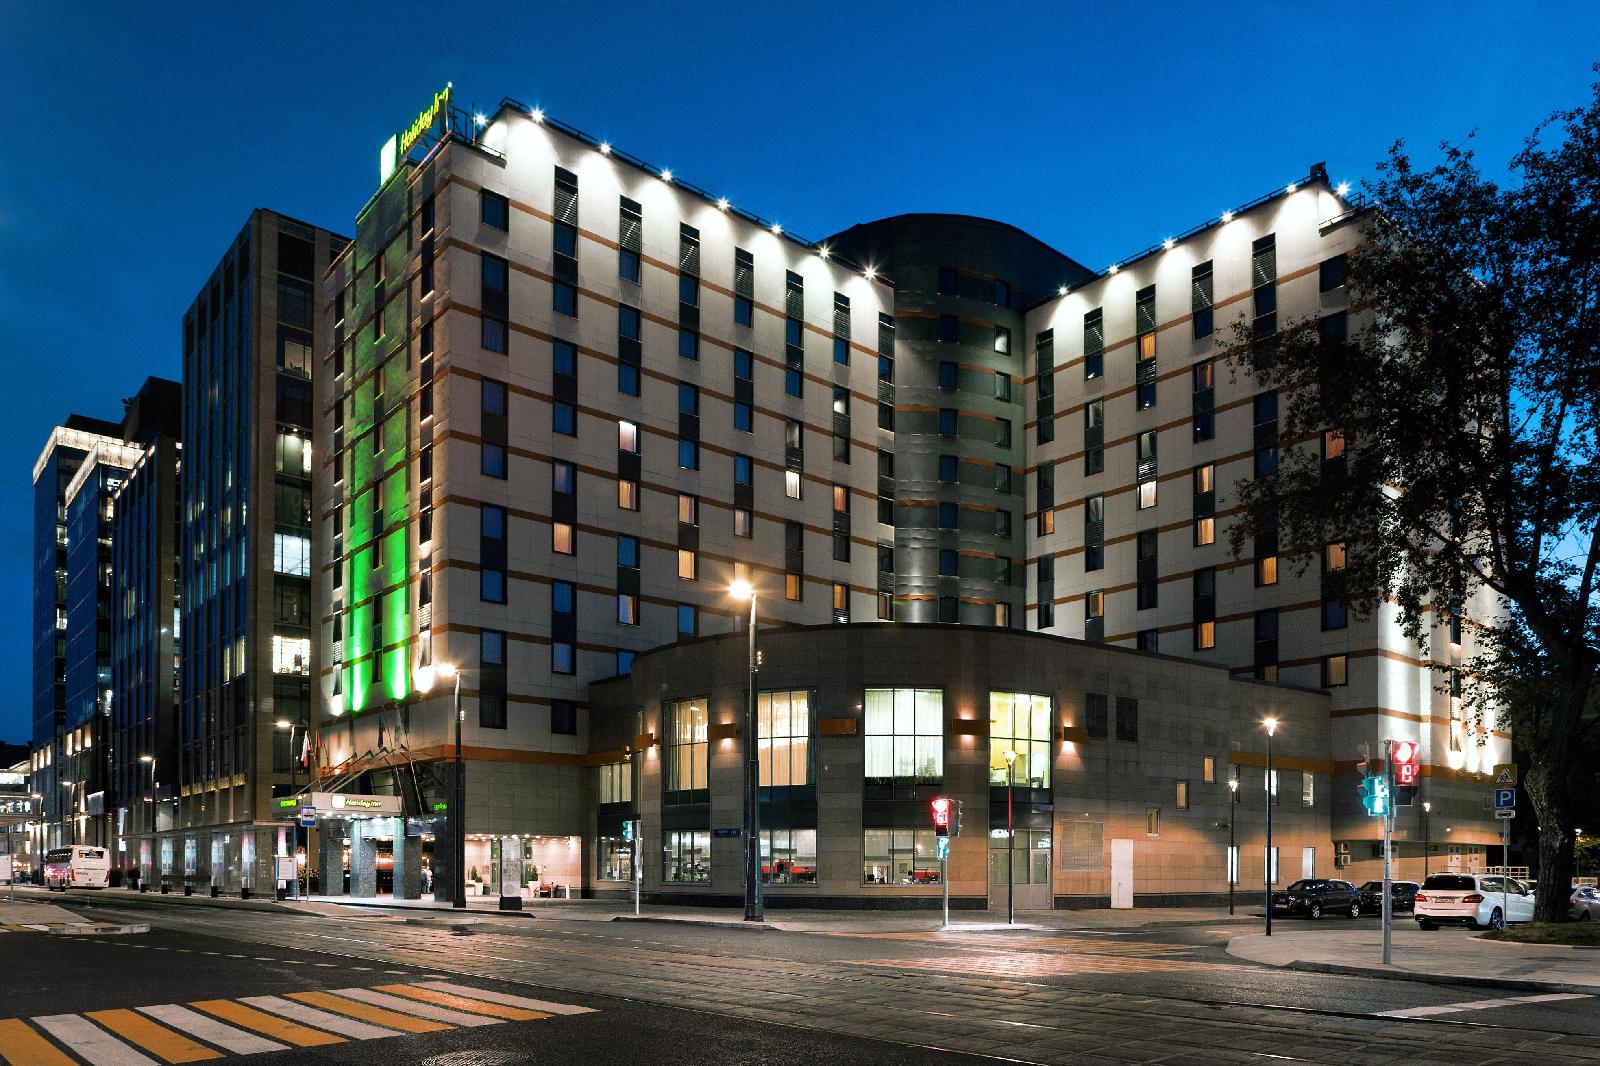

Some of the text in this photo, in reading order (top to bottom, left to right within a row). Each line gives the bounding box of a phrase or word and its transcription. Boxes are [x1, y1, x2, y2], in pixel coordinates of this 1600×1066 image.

[400, 104, 433, 155] Holiday
[345, 799, 371, 808] Holiday
[1500, 791, 1512, 806] P
